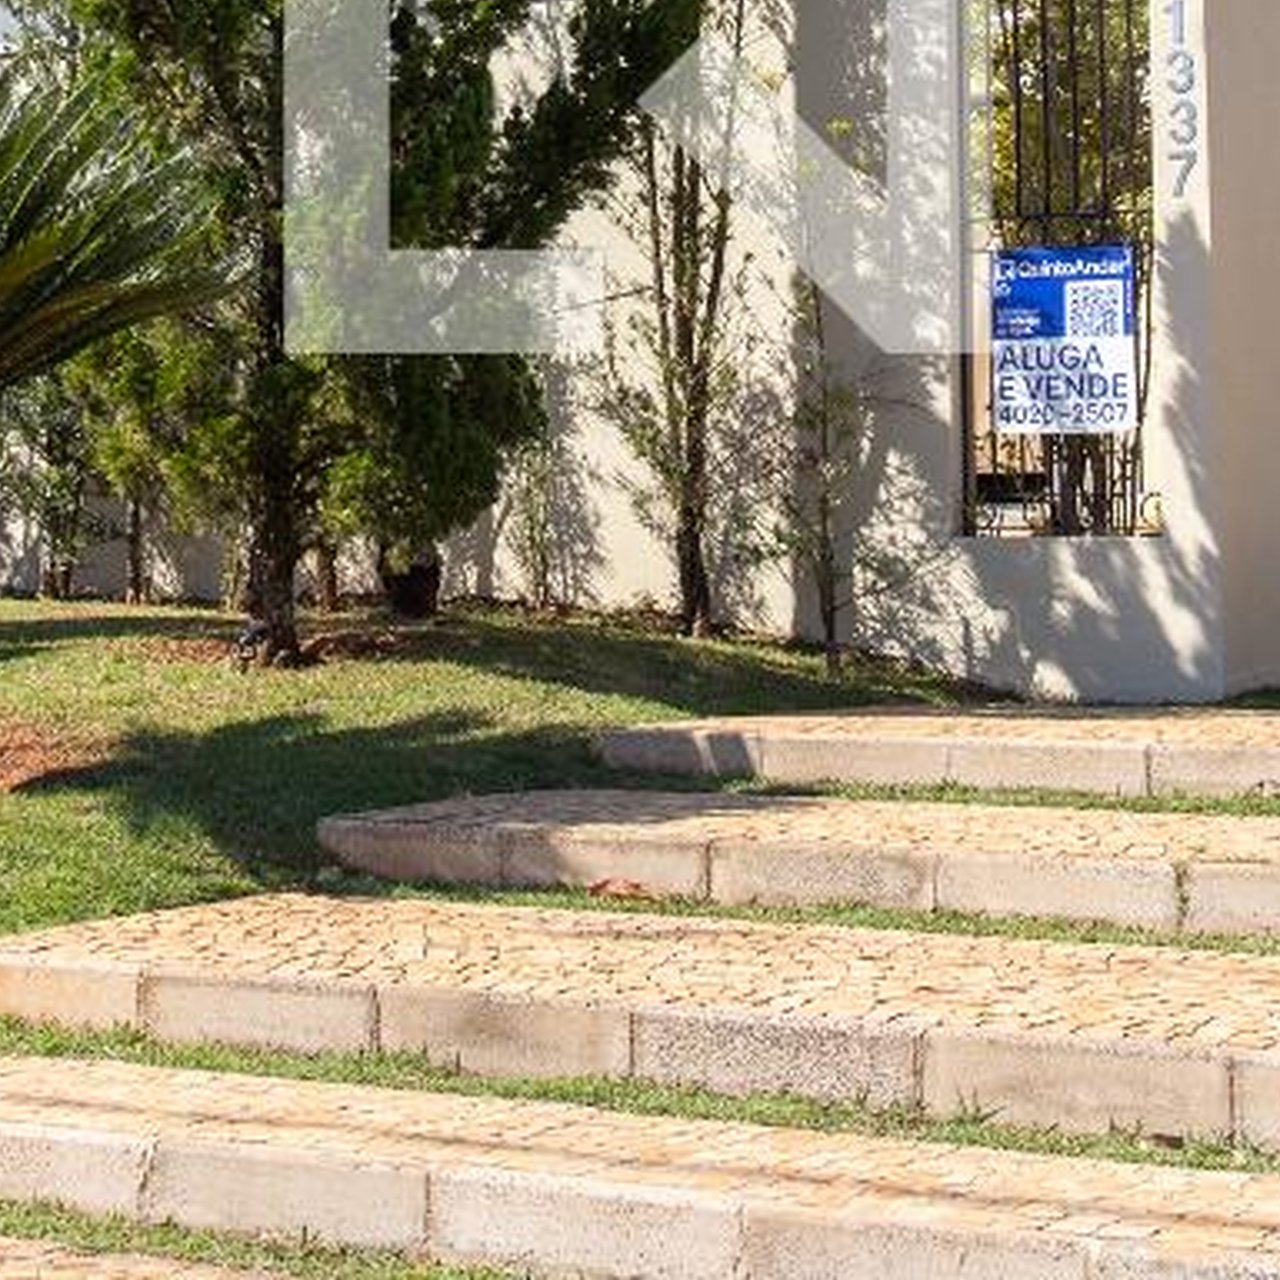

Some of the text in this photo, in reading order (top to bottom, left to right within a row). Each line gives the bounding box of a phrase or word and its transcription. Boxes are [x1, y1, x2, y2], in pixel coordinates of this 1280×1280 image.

[1164, 0, 1197, 198] 1337
[1018, 258, 1126, 277] QuintoAndar
[998, 344, 1104, 372] ALUGA
[999, 372, 1129, 401] E VENDE
[999, 402, 1129, 426] 4020-2507
